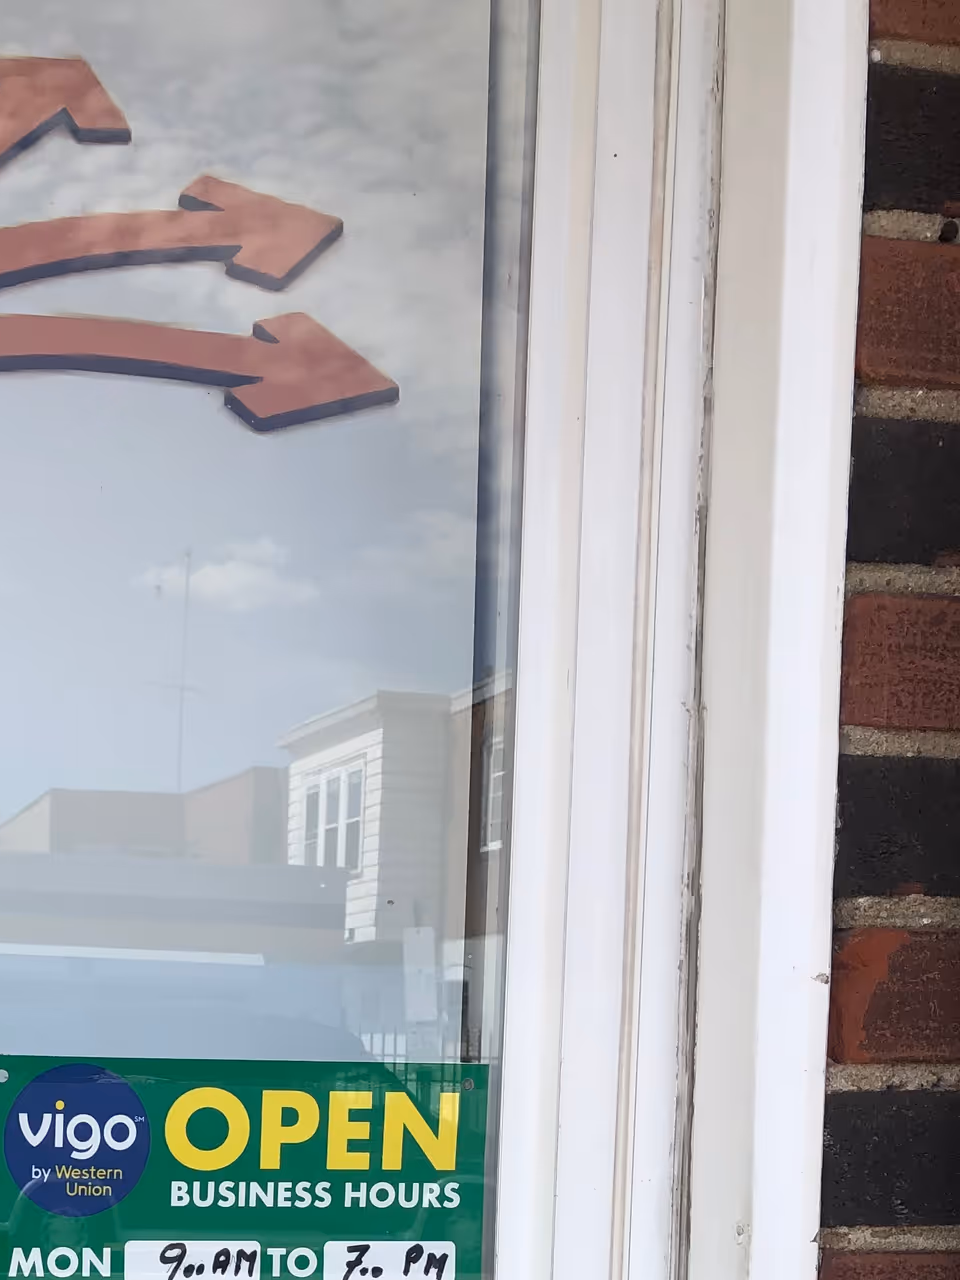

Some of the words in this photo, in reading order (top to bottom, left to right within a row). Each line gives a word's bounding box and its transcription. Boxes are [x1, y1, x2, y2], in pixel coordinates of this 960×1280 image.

[18, 1100, 137, 1160] vigo
[164, 1087, 460, 1171] OPEN
[31, 1165, 50, 1183] by
[54, 1165, 123, 1181] Western
[65, 1182, 112, 1197] Union
[170, 1181, 332, 1208] BUSINESS
[344, 1181, 461, 1209] HOURS
[8, 1247, 111, 1278] MON
[267, 1247, 317, 1278] TO
